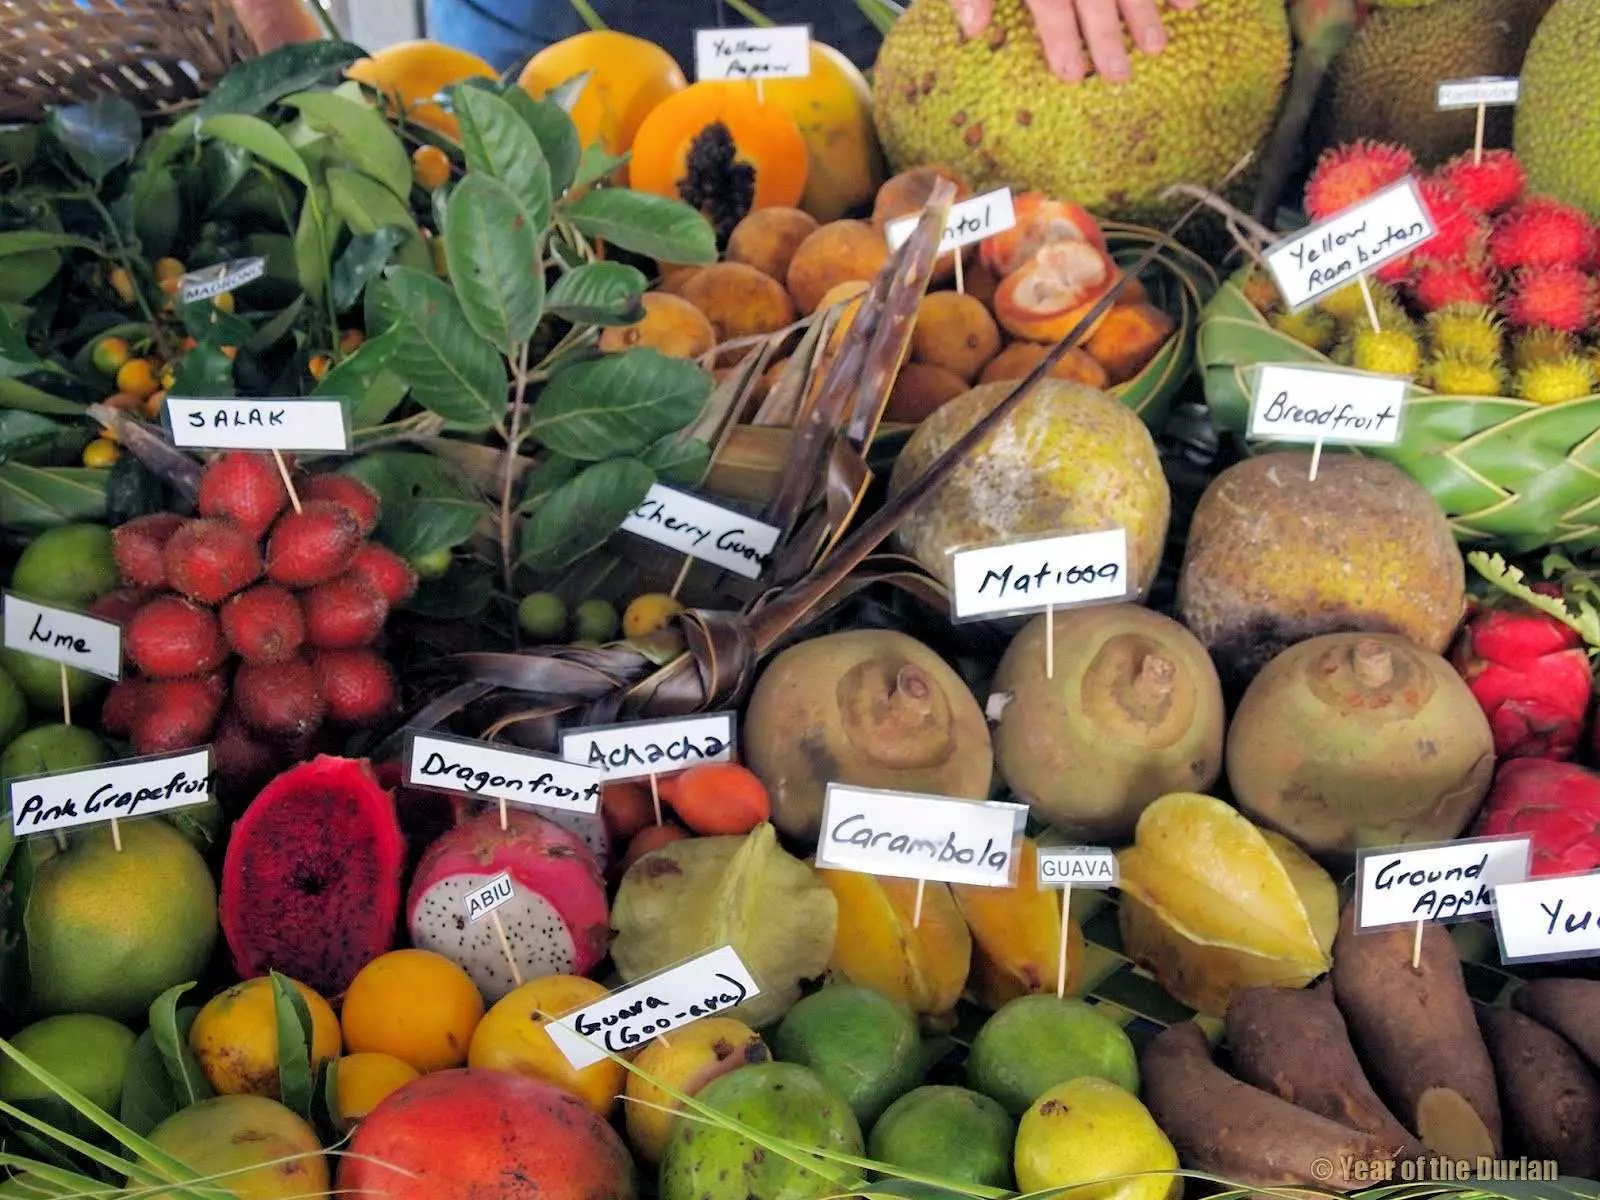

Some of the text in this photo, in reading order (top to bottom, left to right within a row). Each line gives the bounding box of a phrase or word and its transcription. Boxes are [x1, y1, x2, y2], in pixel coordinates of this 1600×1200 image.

[713, 38, 774, 57] Yellow
[1290, 220, 1366, 269] Yellow
[1309, 222, 1423, 291] Rambutan
[188, 408, 285, 427] SALAK
[1264, 391, 1395, 430] Breadfruit
[635, 500, 711, 546] Cherry
[977, 561, 1119, 598] Matissa
[29, 613, 92, 653] Lime
[588, 736, 732, 772] Achacha
[420, 752, 601, 801] Dragonfruit
[16, 771, 218, 826] Pink Grapefruit
[831, 814, 1009, 872] Carambola
[1042, 860, 1112, 877] GUAVA
[1375, 853, 1489, 889] Ground
[471, 879, 511, 915] ABIU
[1540, 898, 1600, 935] Yu
